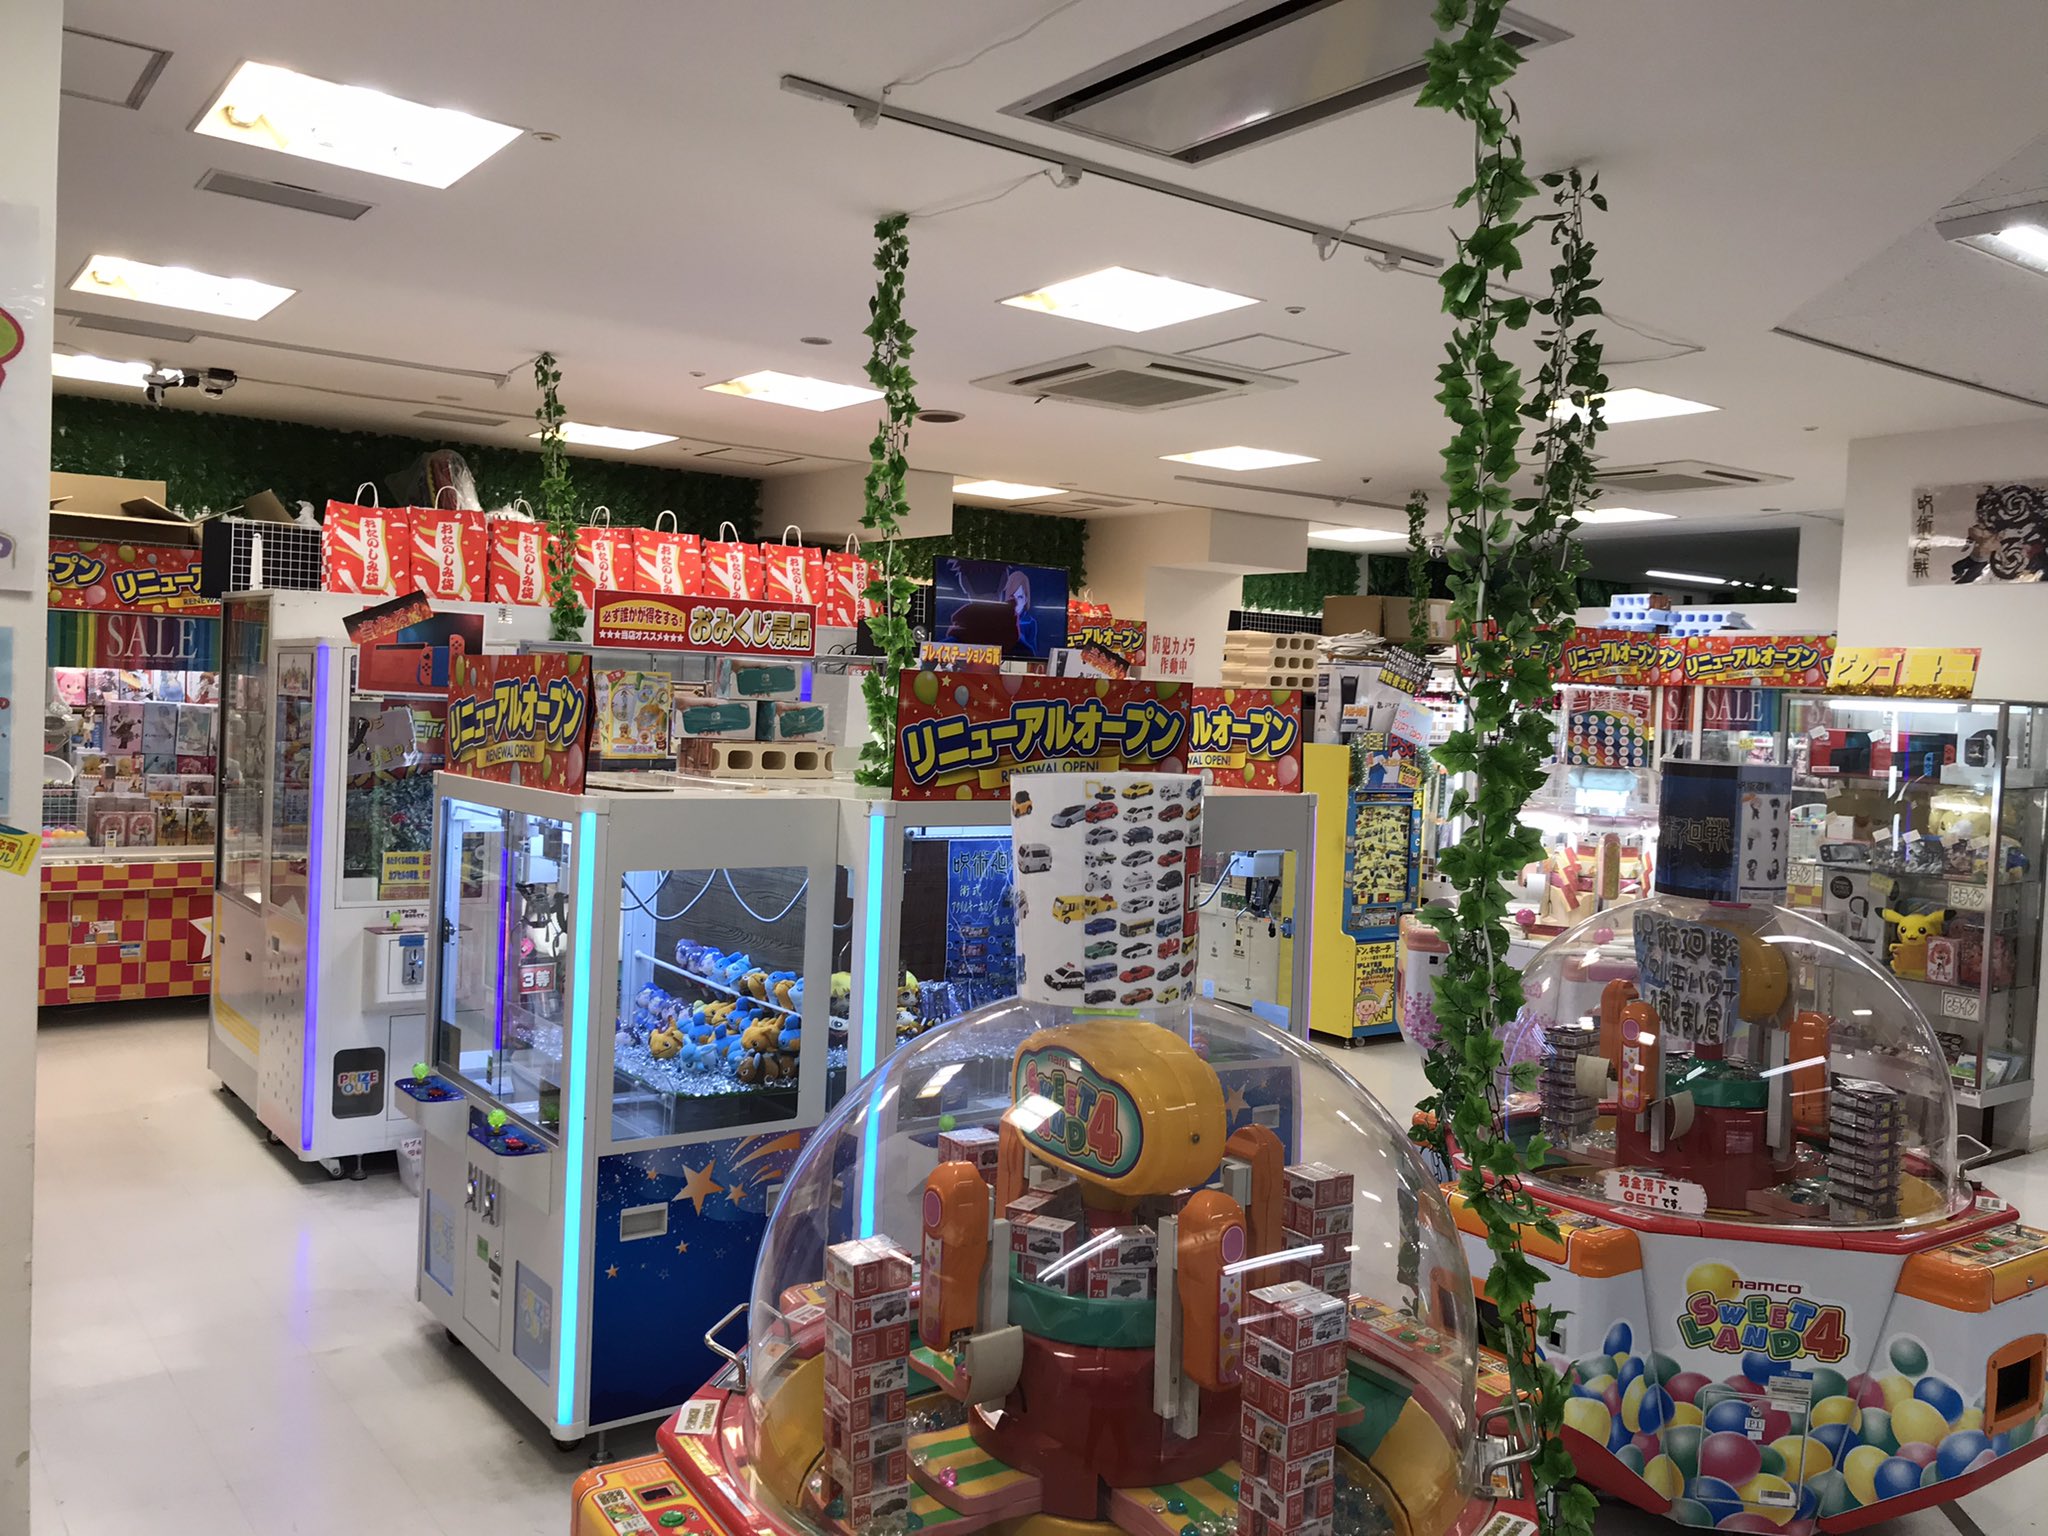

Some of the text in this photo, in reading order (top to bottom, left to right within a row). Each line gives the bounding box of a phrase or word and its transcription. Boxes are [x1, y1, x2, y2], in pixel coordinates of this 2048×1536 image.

[363, 518, 381, 588] おたのしみ袋
[440, 522, 456, 592] おたのしみ袋
[520, 534, 537, 601] おたのしみ袋
[602, 607, 683, 627] 必ず誰かが得をする!
[689, 606, 812, 649] おみくじ景品
[106, 614, 198, 658] SALE
[1151, 634, 1196, 655] 防犯カメラ
[1159, 656, 1187, 674] 作動中
[1567, 640, 1658, 676] リニューアルオープン
[1684, 643, 1821, 679] リニューアルオープン
[1572, 691, 1649, 717] 当選番号
[1705, 688, 1764, 722] SALE
[449, 675, 586, 760] リニューアルオープン
[900, 698, 1187, 788] リニューアルオープン
[1952, 886, 1986, 906] 3ライン
[522, 971, 551, 988] 3等
[1944, 996, 1978, 1017] 2ライン
[339, 1070, 378, 1085] PRIZE
[341, 1081, 371, 1096] OUT
[1088, 1092, 1121, 1165] 4
[1619, 1174, 1679, 1196] 完全落下で
[1622, 1190, 1682, 1210] GETです。
[1104, 1258, 1117, 1267] 27
[1090, 1271, 1108, 1281] トミカ
[1093, 1289, 1106, 1298] 73
[1731, 1279, 1802, 1295] namco
[857, 1320, 869, 1328] 44
[1690, 1297, 1817, 1333] SWEET
[1681, 1309, 1846, 1359] LAND 4
[857, 1387, 868, 1396] 12
[1291, 1408, 1304, 1419] 30
